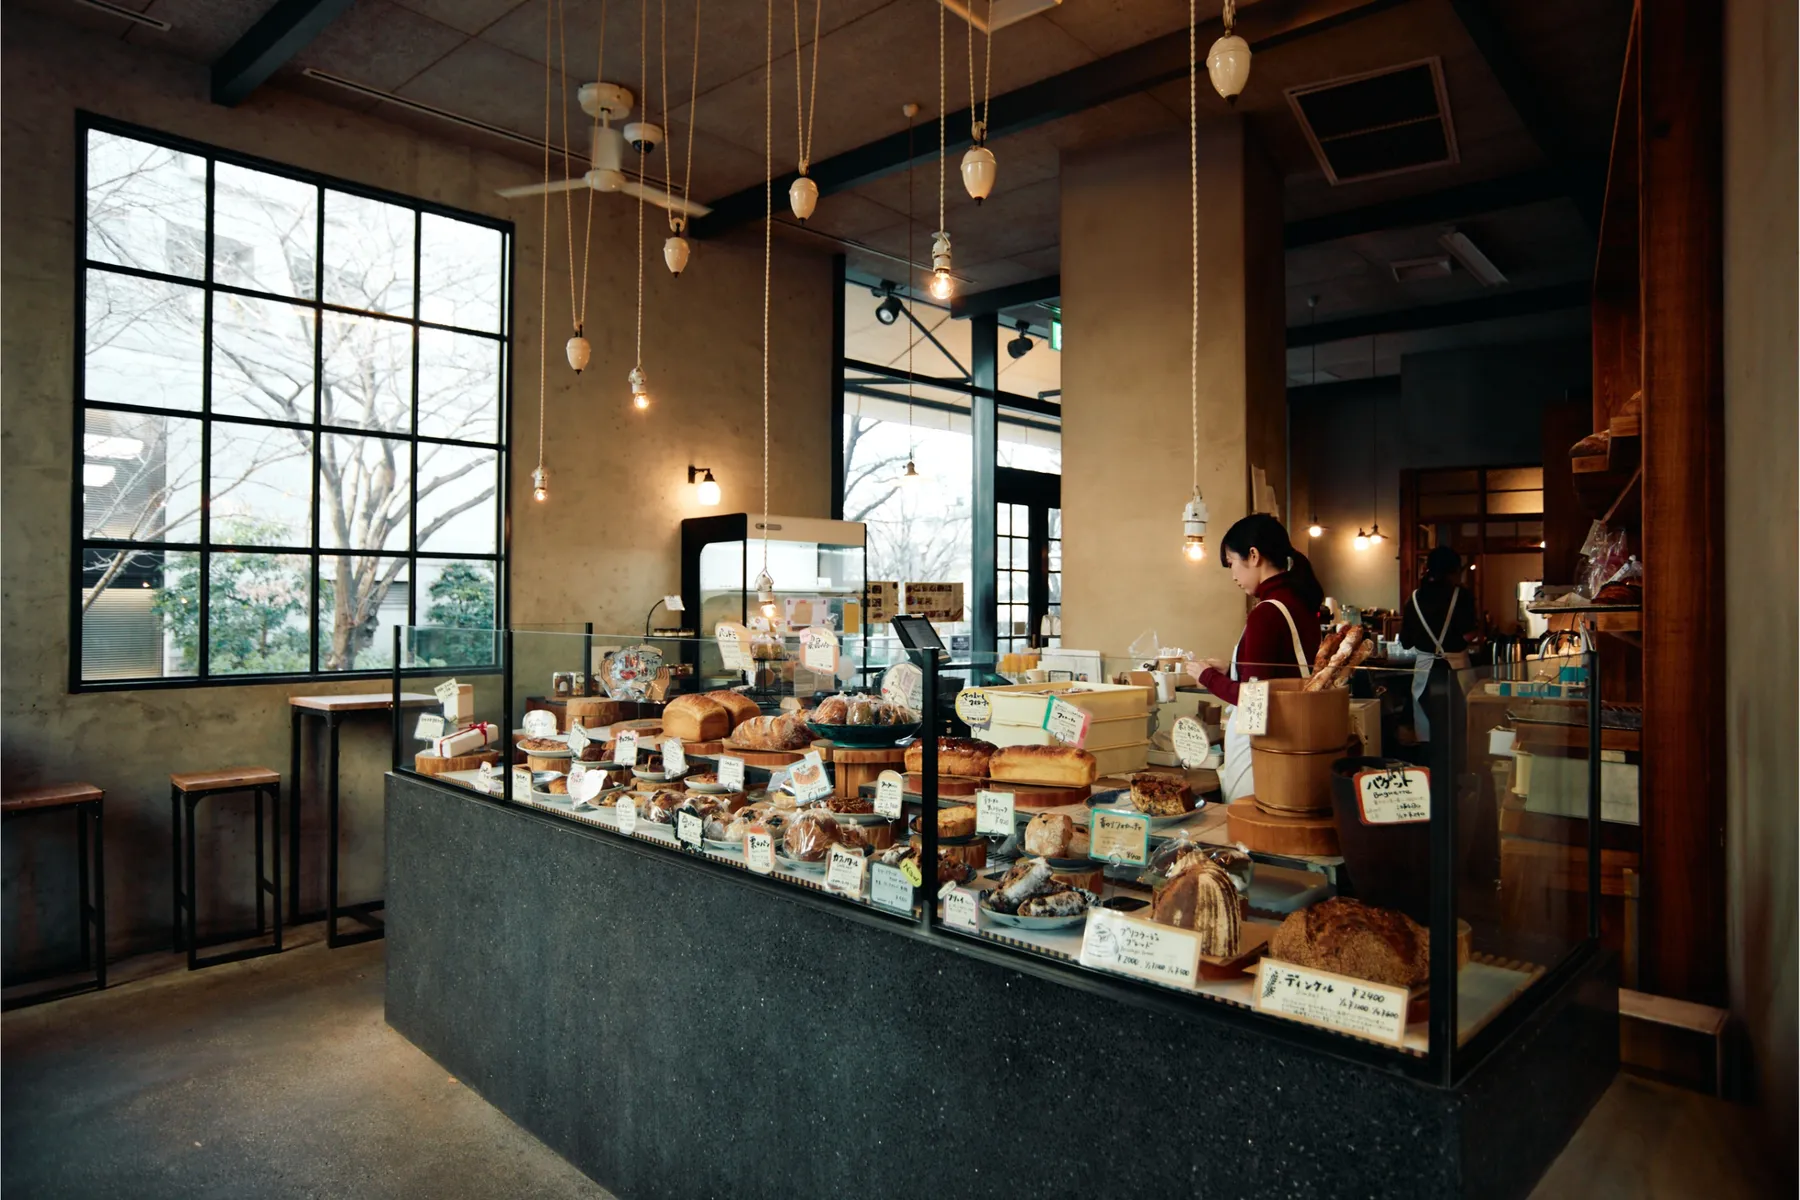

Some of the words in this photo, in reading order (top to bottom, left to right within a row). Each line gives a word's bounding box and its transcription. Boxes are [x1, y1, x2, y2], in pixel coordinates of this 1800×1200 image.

[1367, 774, 1413, 790] バゲット
[1284, 973, 1334, 993] ディンケル
[1351, 987, 1385, 1003] ¥2400
